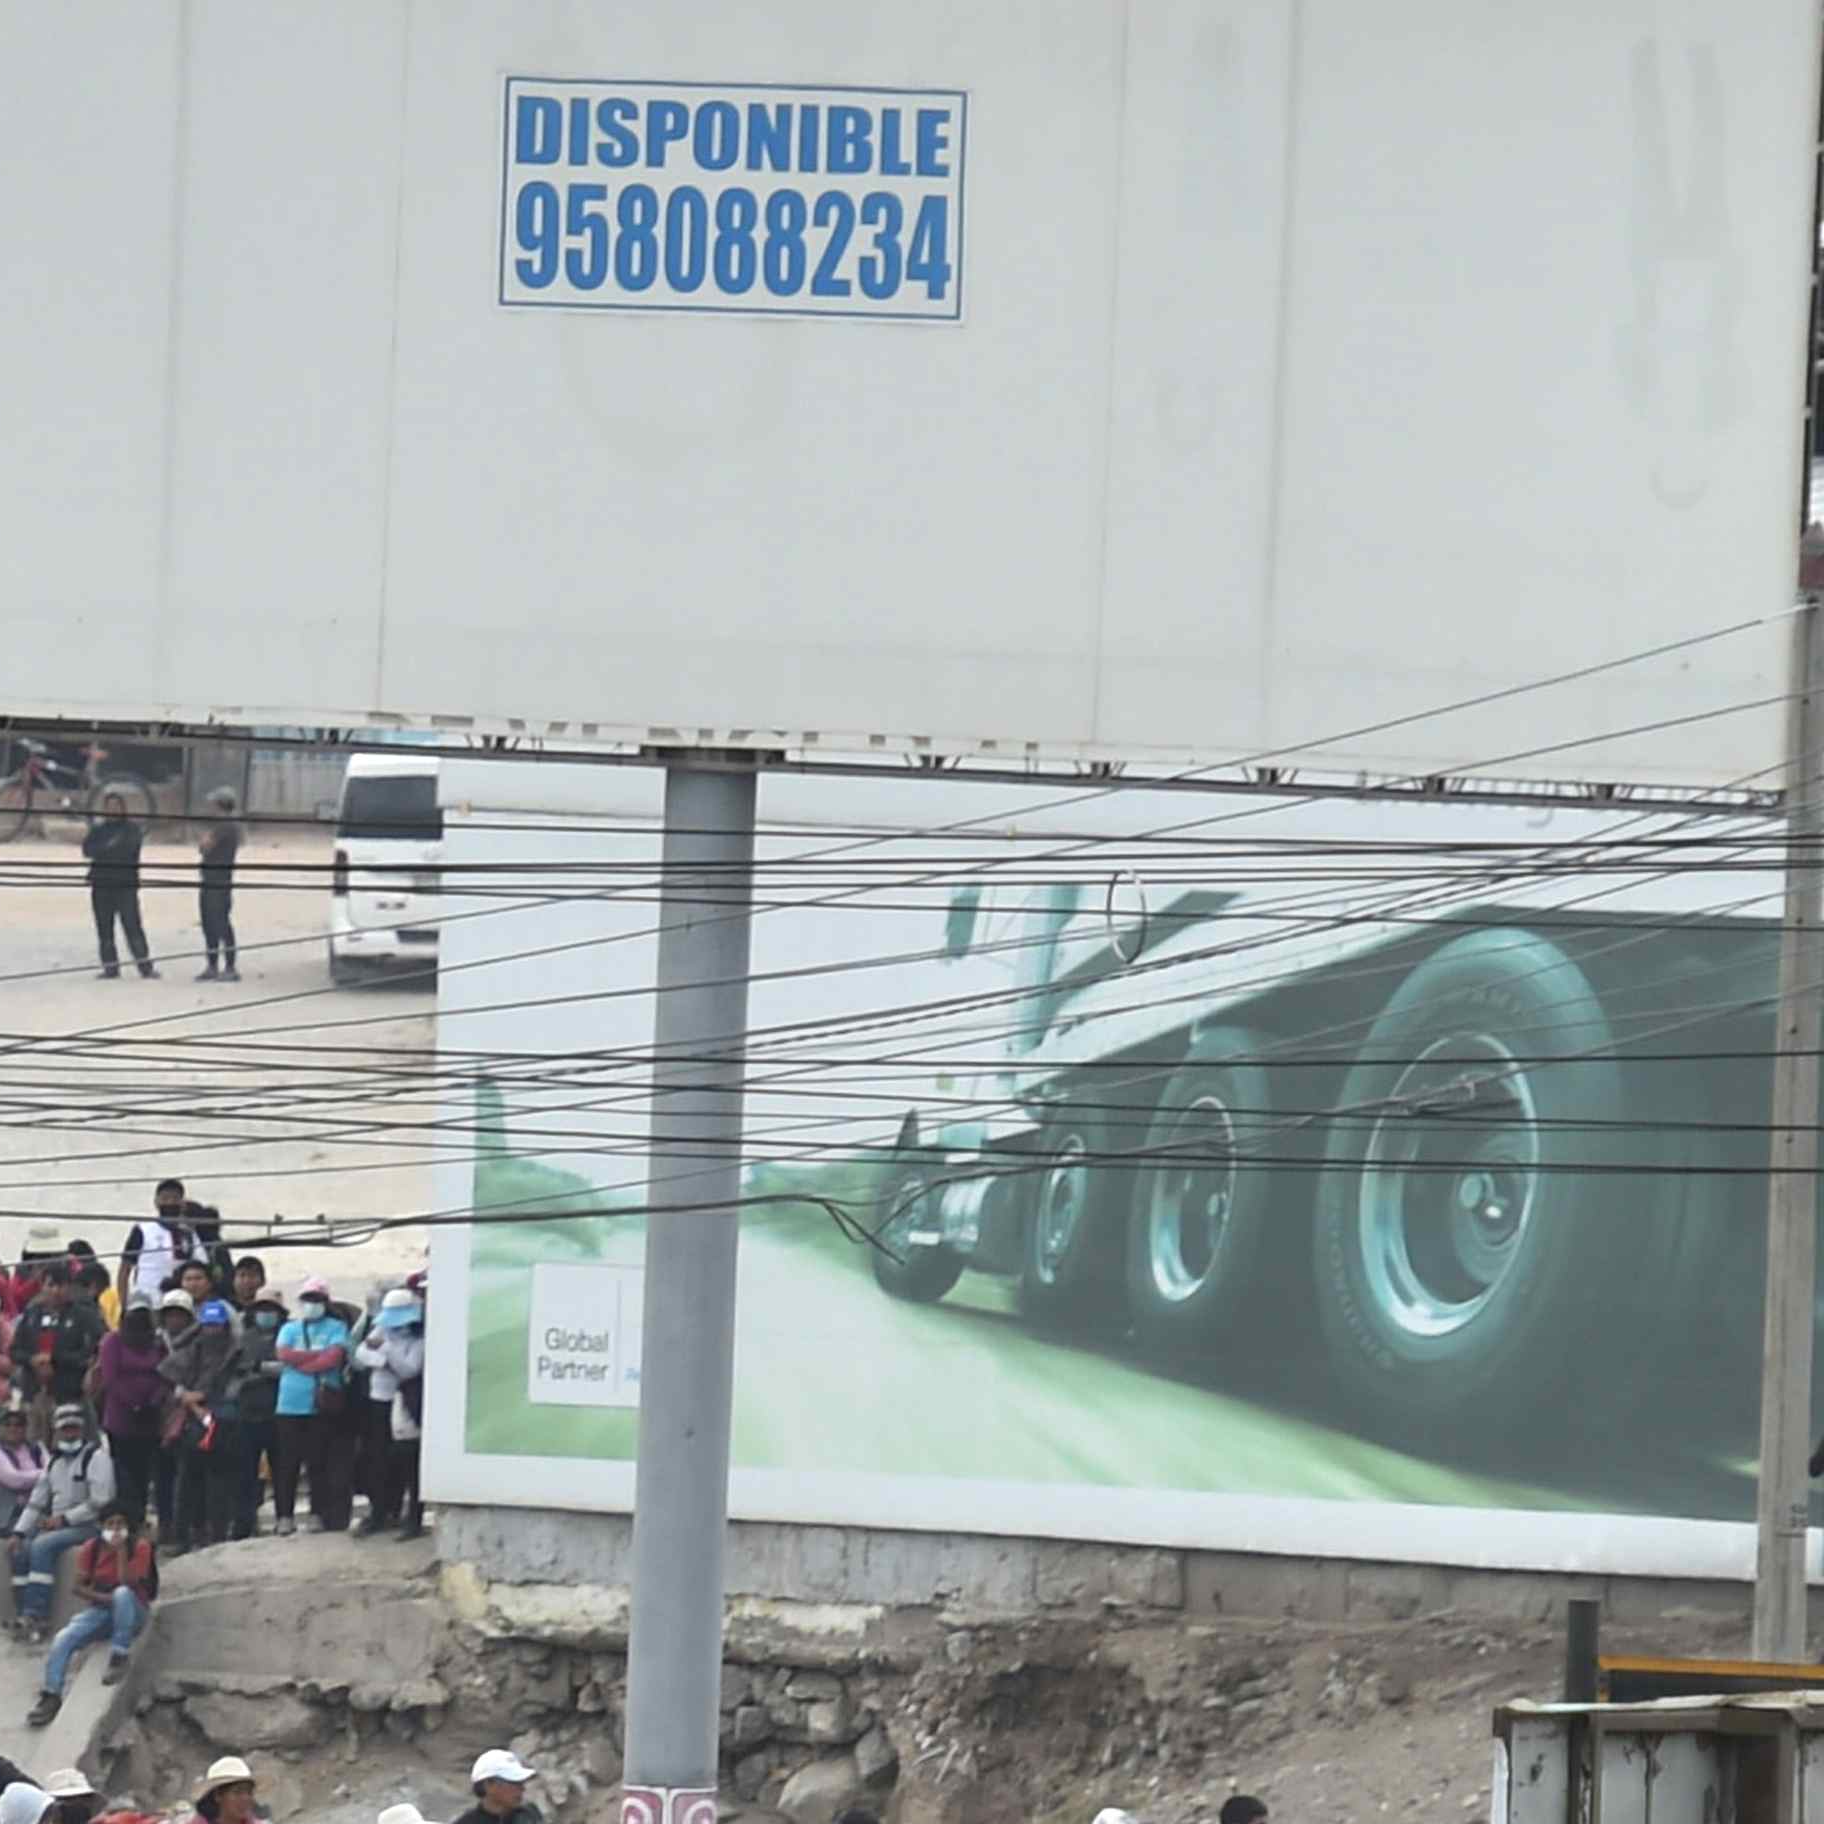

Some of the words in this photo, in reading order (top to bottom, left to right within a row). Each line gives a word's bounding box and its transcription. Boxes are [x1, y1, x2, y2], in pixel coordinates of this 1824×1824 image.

[514, 94, 952, 178] DISPONIBLE
[514, 180, 952, 302] 958088234
[544, 1327, 609, 1353] Global
[537, 1355, 609, 1382] Partner
